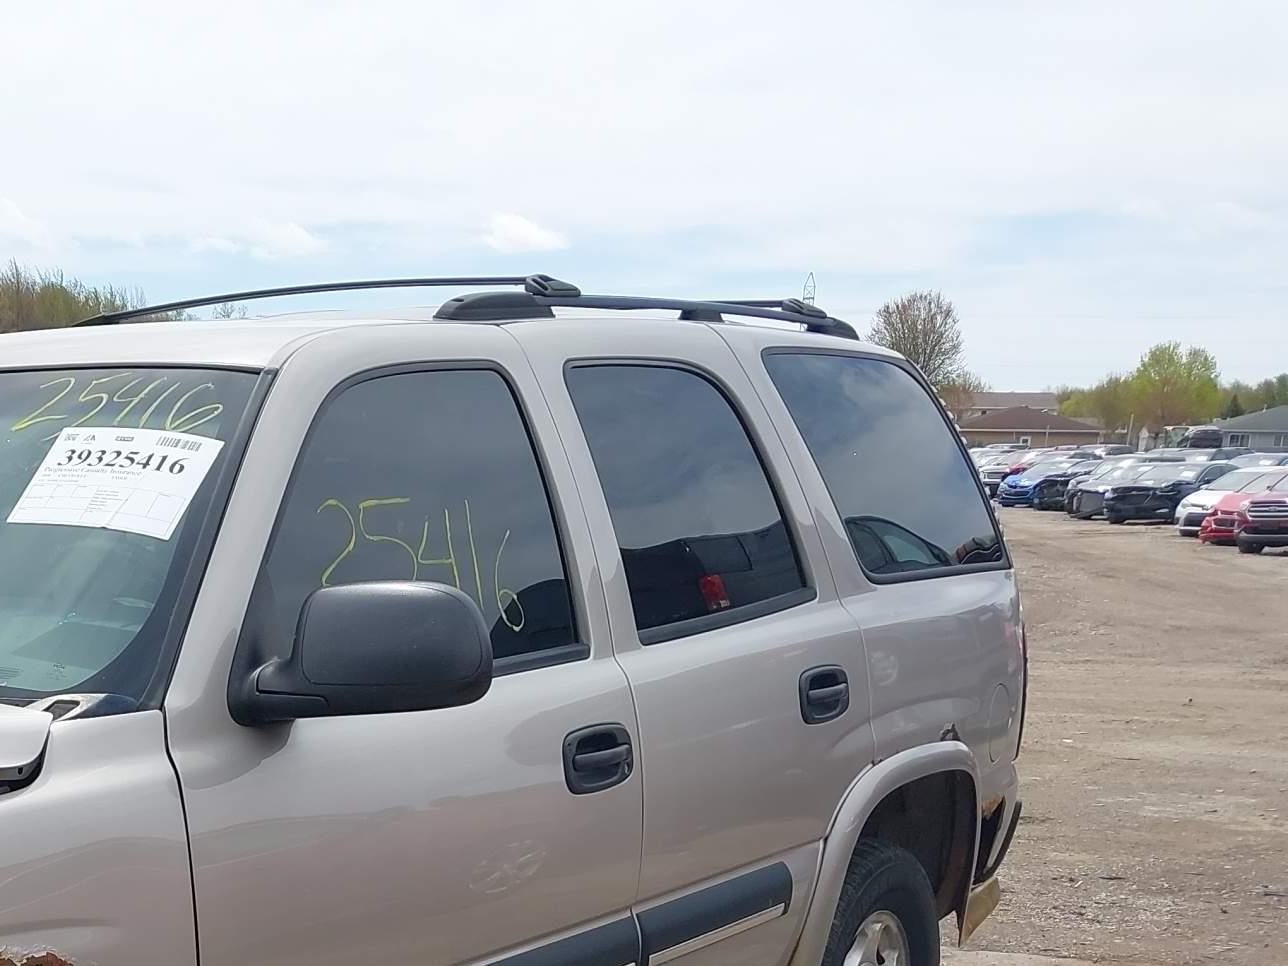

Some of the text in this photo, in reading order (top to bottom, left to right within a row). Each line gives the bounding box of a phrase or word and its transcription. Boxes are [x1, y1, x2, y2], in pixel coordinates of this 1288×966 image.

[11, 371, 224, 441] 25416
[57, 448, 191, 475] 39325416
[316, 496, 526, 633] 25416
